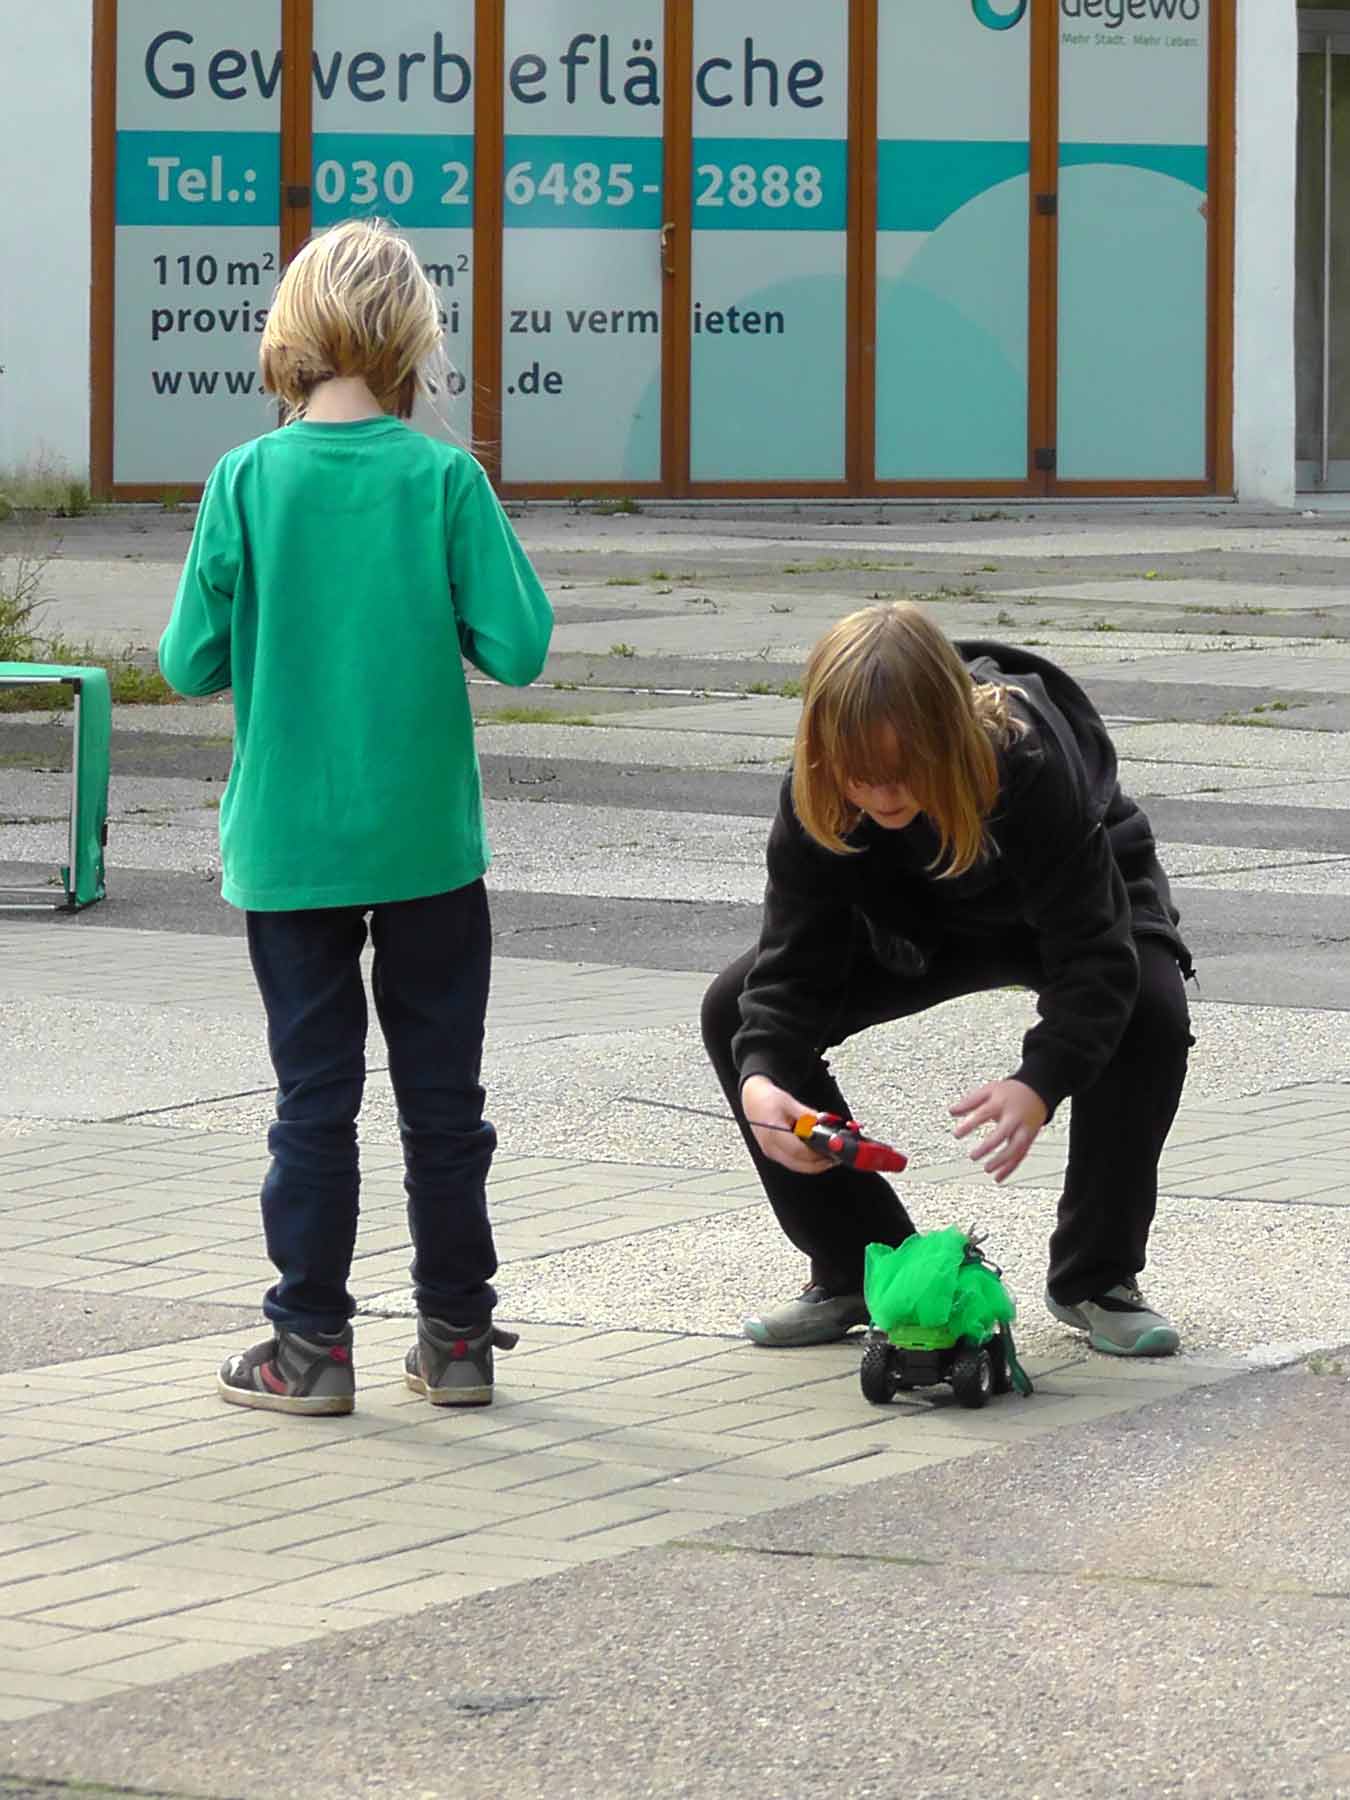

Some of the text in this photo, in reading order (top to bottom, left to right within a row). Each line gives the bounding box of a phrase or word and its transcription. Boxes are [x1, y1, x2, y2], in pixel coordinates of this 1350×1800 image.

[147, 155, 257, 202] Tel.:
[315, 159, 414, 204] 030
[153, 255, 218, 286] 110
[508, 309, 552, 335] zu
